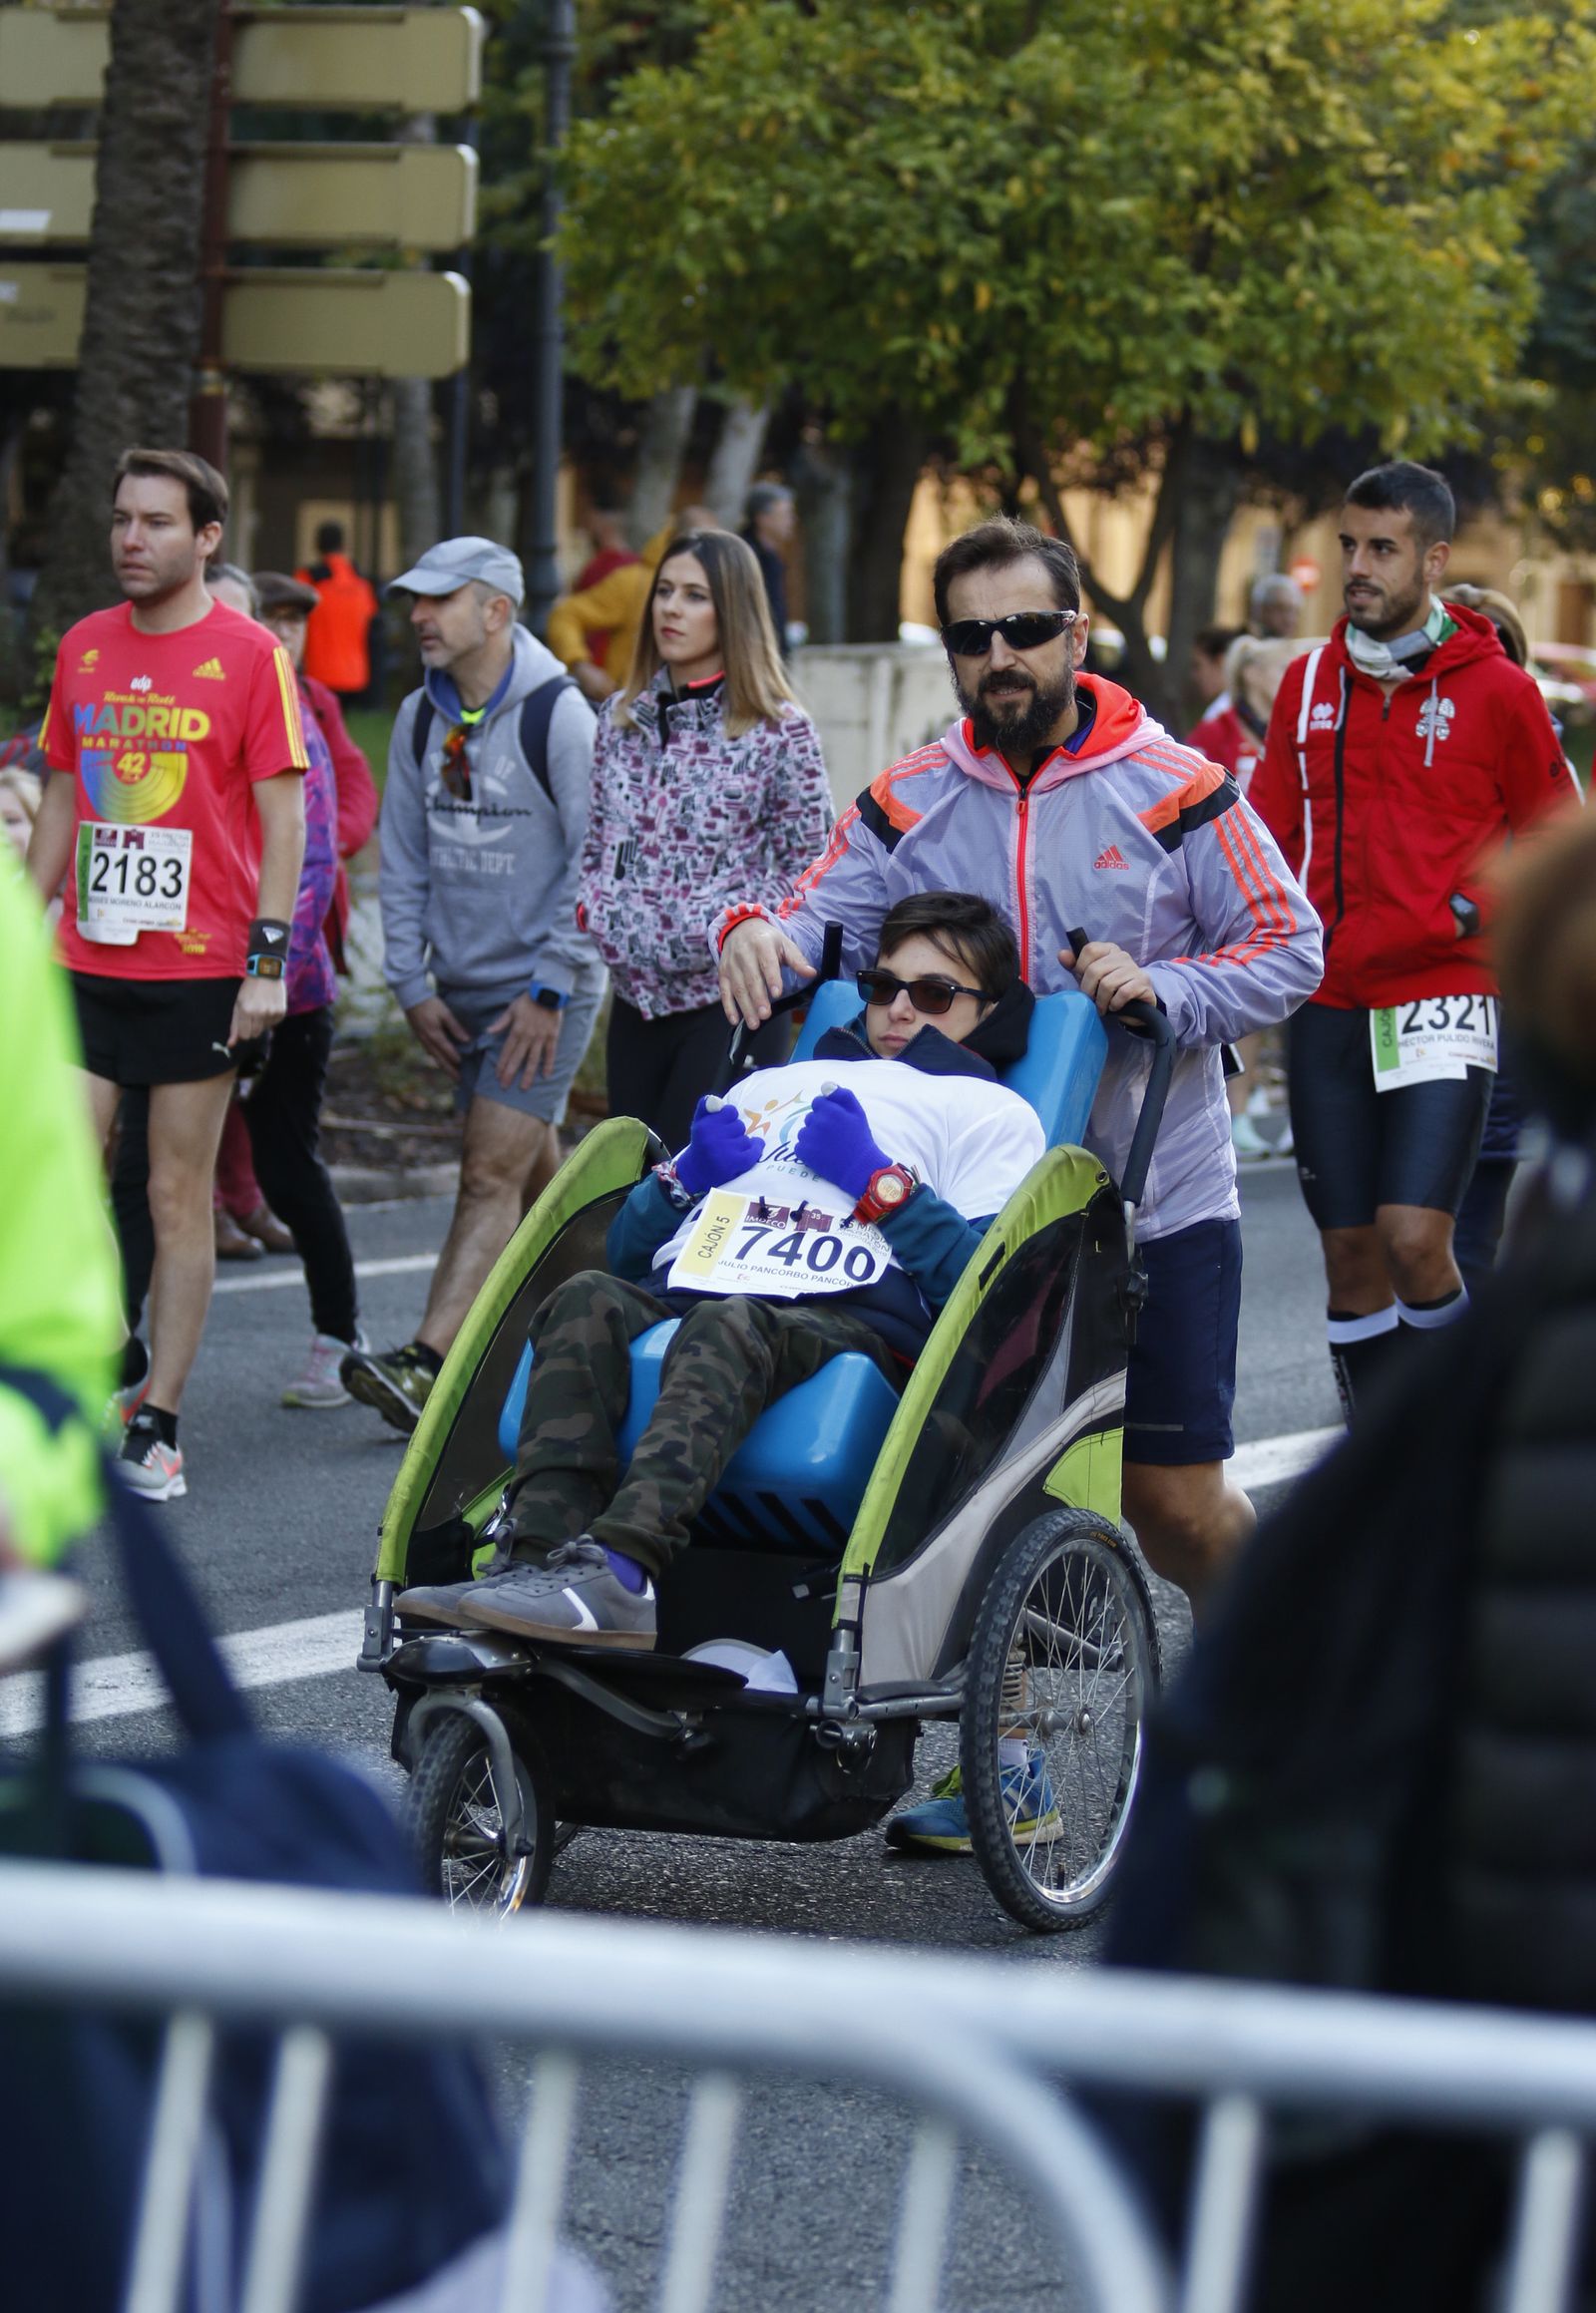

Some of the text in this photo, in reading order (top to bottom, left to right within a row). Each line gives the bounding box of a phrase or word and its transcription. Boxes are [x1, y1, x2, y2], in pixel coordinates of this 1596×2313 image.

[74, 702, 211, 741] MADRID
[82, 736, 188, 752] MARATHON
[117, 751, 147, 776] 42
[91, 851, 183, 899] 2183
[1093, 861, 1129, 871] adidas
[1401, 994, 1490, 1035] 2321
[1437, 1031, 1470, 1044] PULIDO
[766, 1164, 820, 1183] PUEDE
[697, 1224, 726, 1259] CAJÓN
[734, 1226, 877, 1283] 7400
[717, 1260, 748, 1271] JULIO
[750, 1265, 809, 1281] PANCORBO
